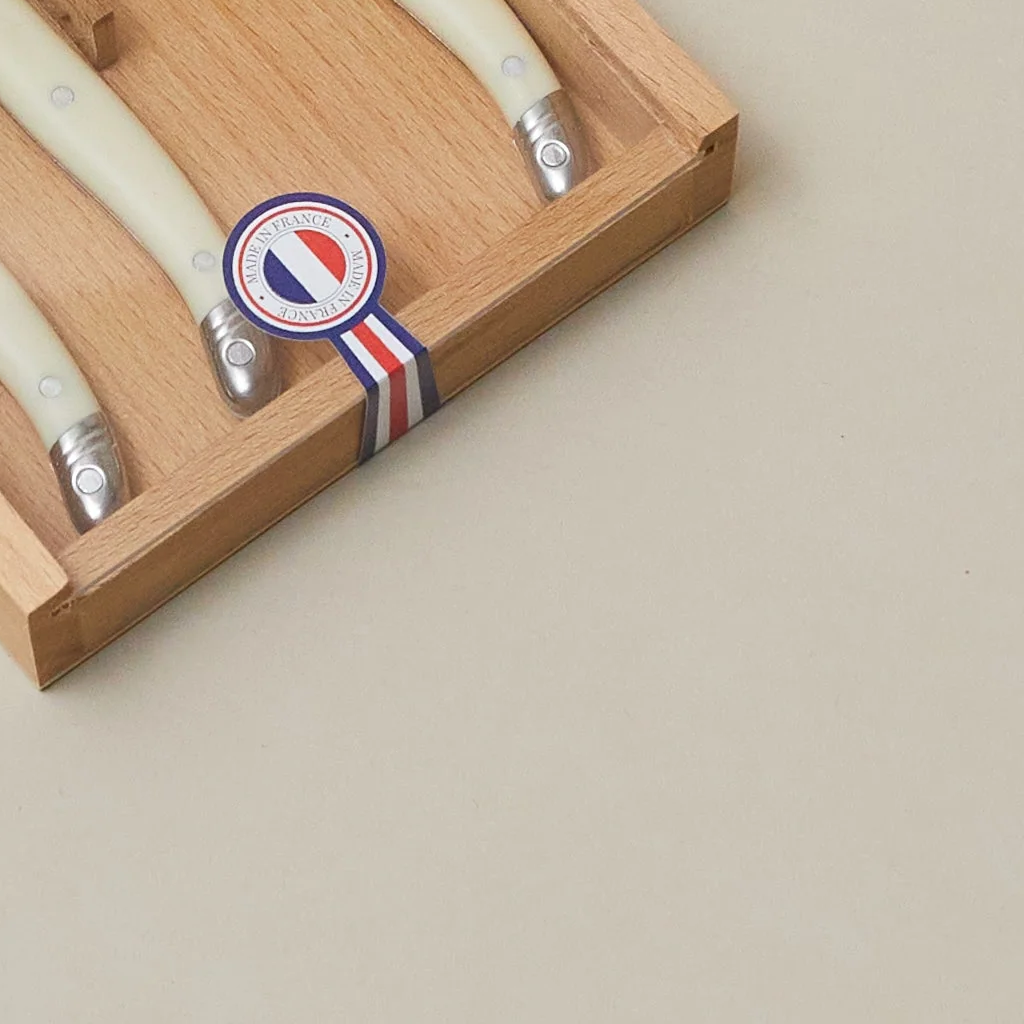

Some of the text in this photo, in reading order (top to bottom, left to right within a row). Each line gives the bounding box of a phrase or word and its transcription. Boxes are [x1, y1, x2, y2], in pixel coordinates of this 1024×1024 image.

[245, 213, 332, 284] MADE IN FRANCE
[277, 249, 365, 321] MADE IN FRANCE
